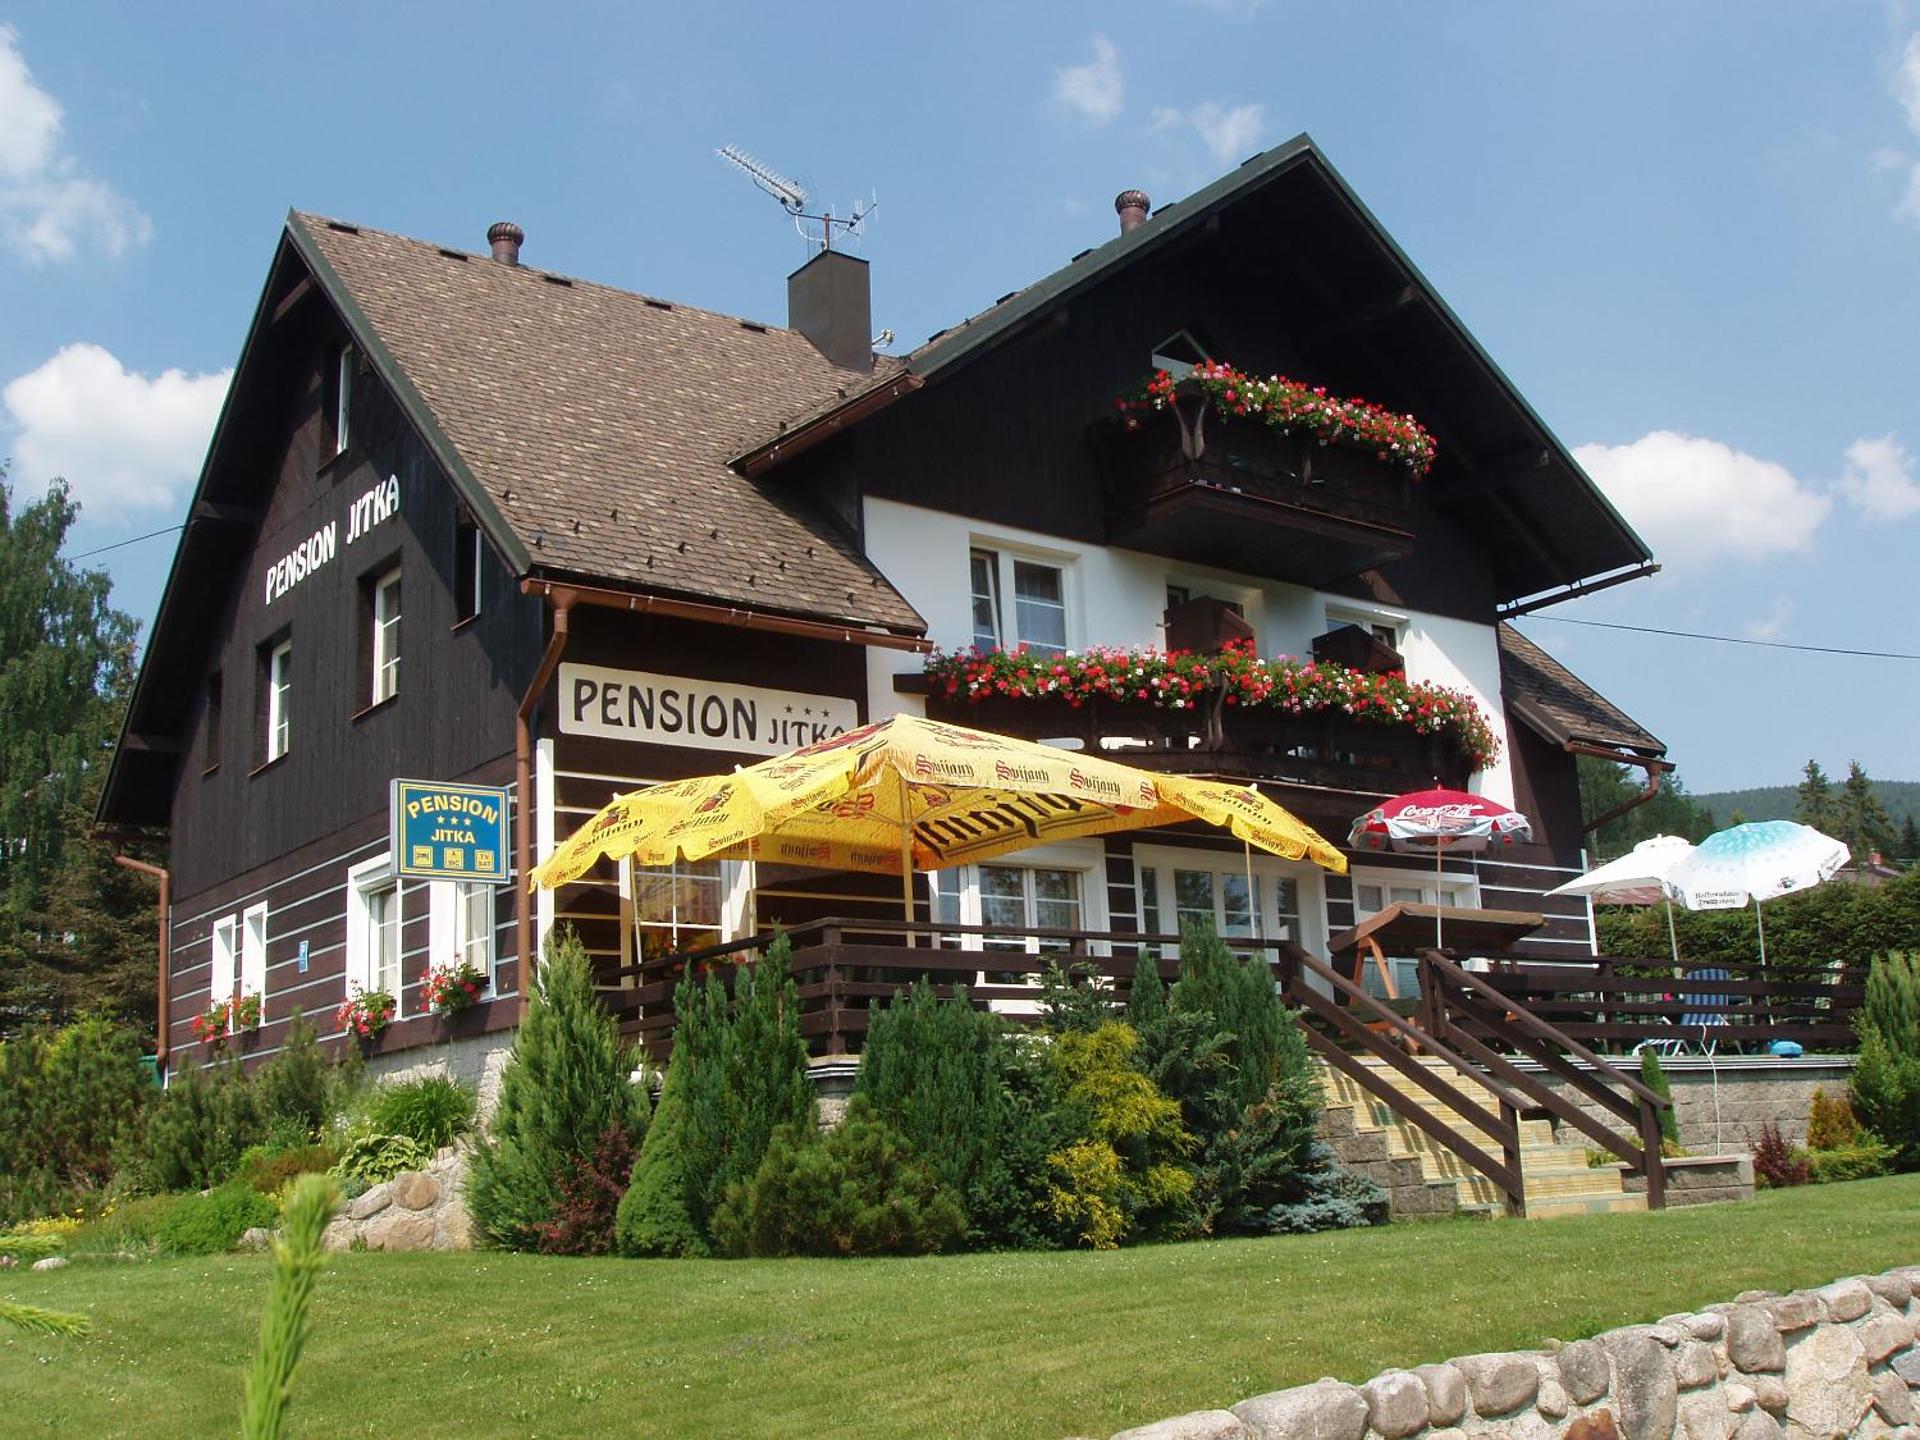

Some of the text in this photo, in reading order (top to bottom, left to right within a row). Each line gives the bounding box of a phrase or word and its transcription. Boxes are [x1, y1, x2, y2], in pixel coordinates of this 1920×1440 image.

[266, 474, 400, 605] PENSION JITKA
[574, 678, 758, 742] PENSION
[407, 794, 498, 825] PENSION
[431, 828, 475, 844] JITKA
